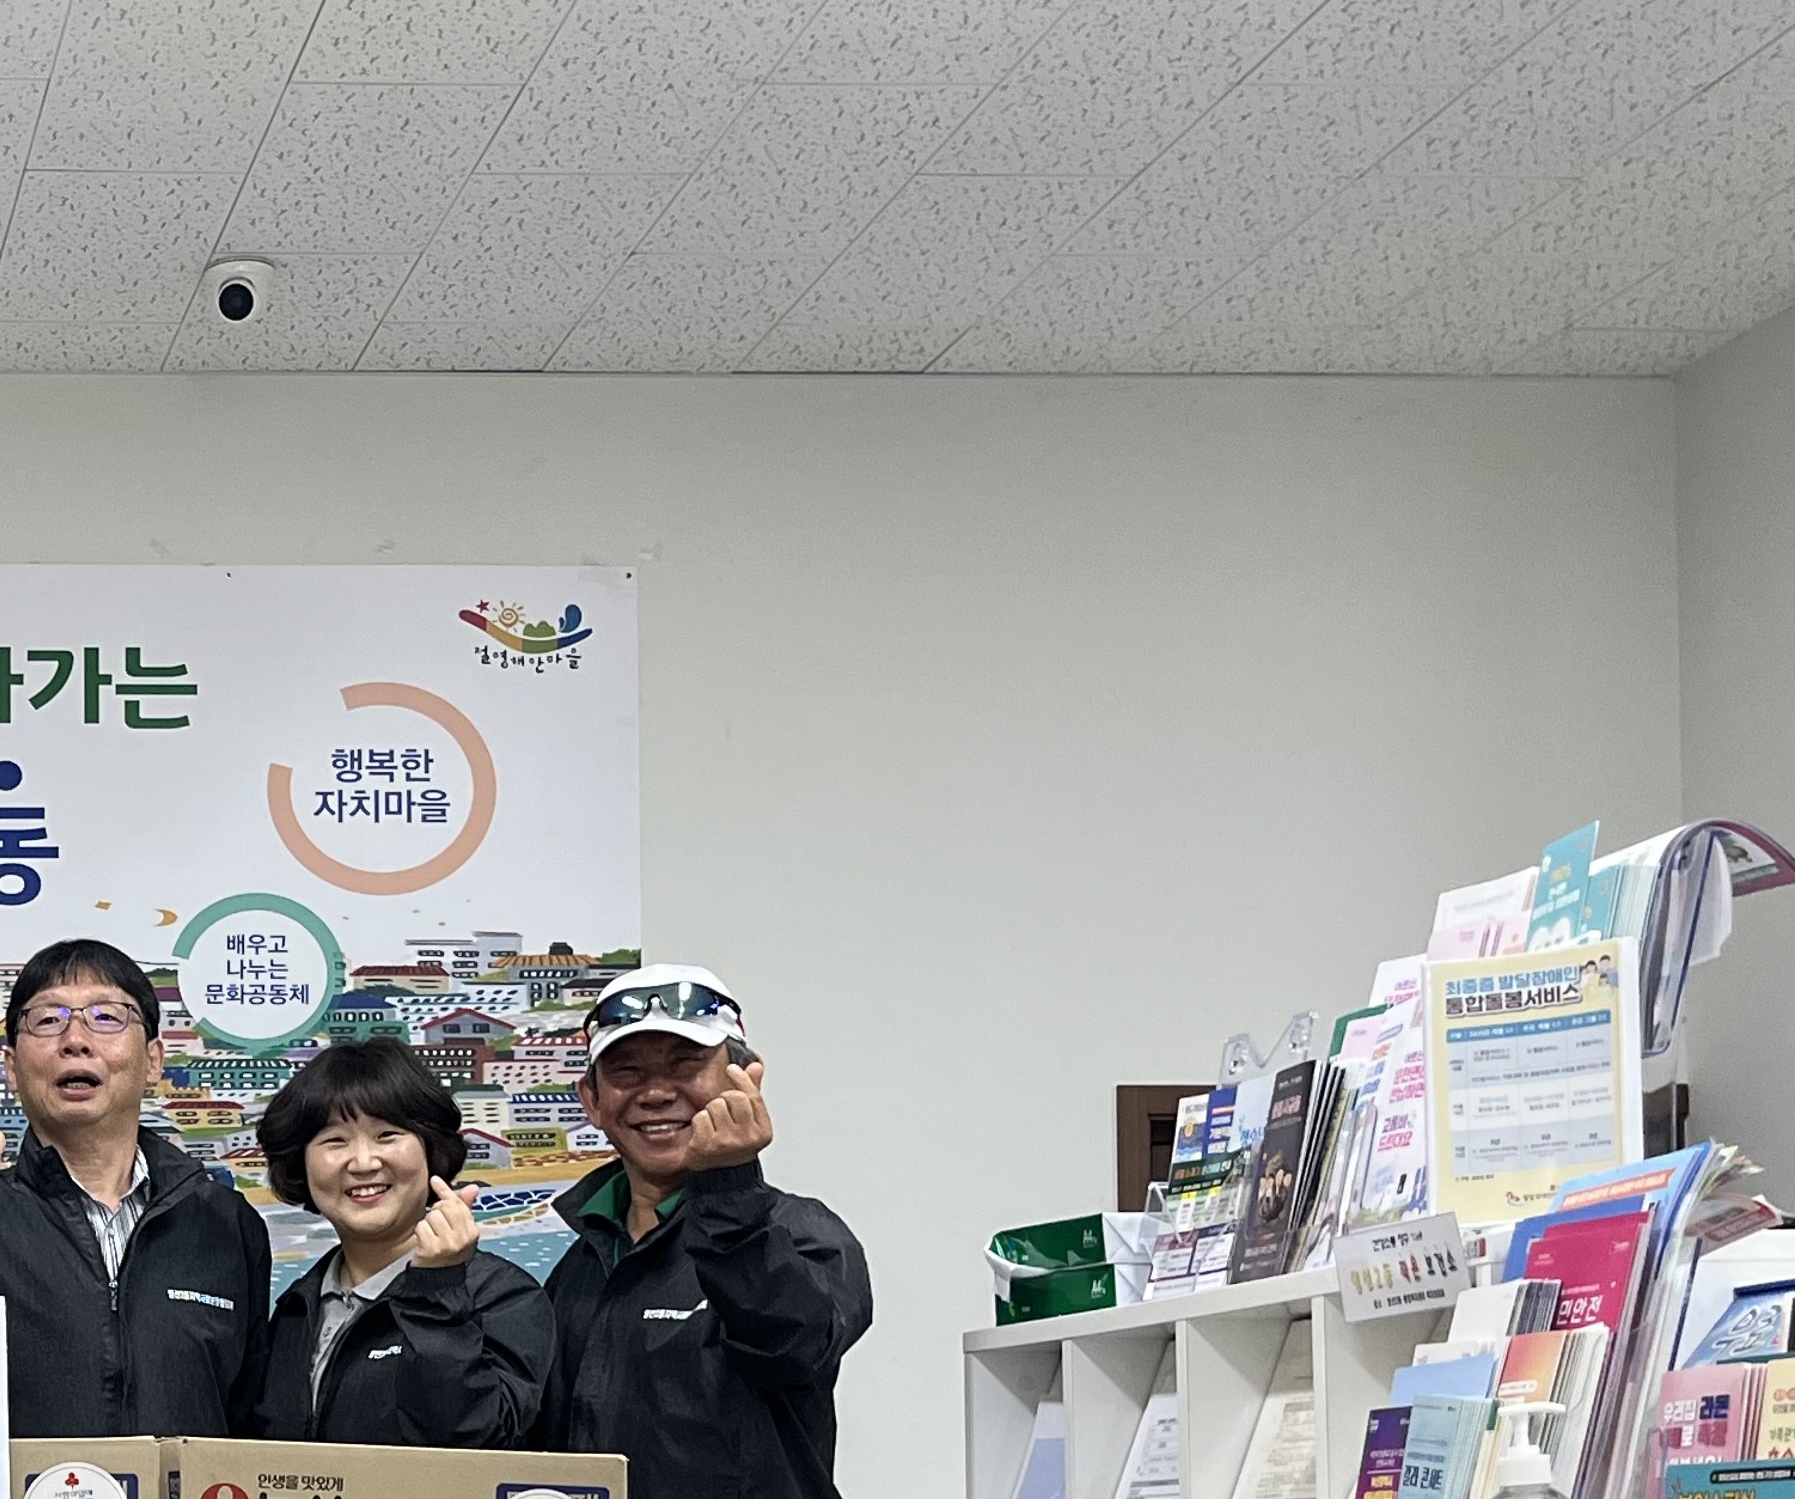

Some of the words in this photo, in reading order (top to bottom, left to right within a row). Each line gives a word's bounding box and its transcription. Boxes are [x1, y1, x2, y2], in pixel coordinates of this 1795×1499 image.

[331, 748, 434, 783] 행복한
[313, 789, 451, 824] 자치마을
[226, 934, 288, 955] 배우고
[227, 958, 288, 979] 나누는
[204, 982, 310, 1006] 문화공동체
[258, 1474, 299, 1489] 인생을
[302, 1475, 344, 1491] 맛있게
